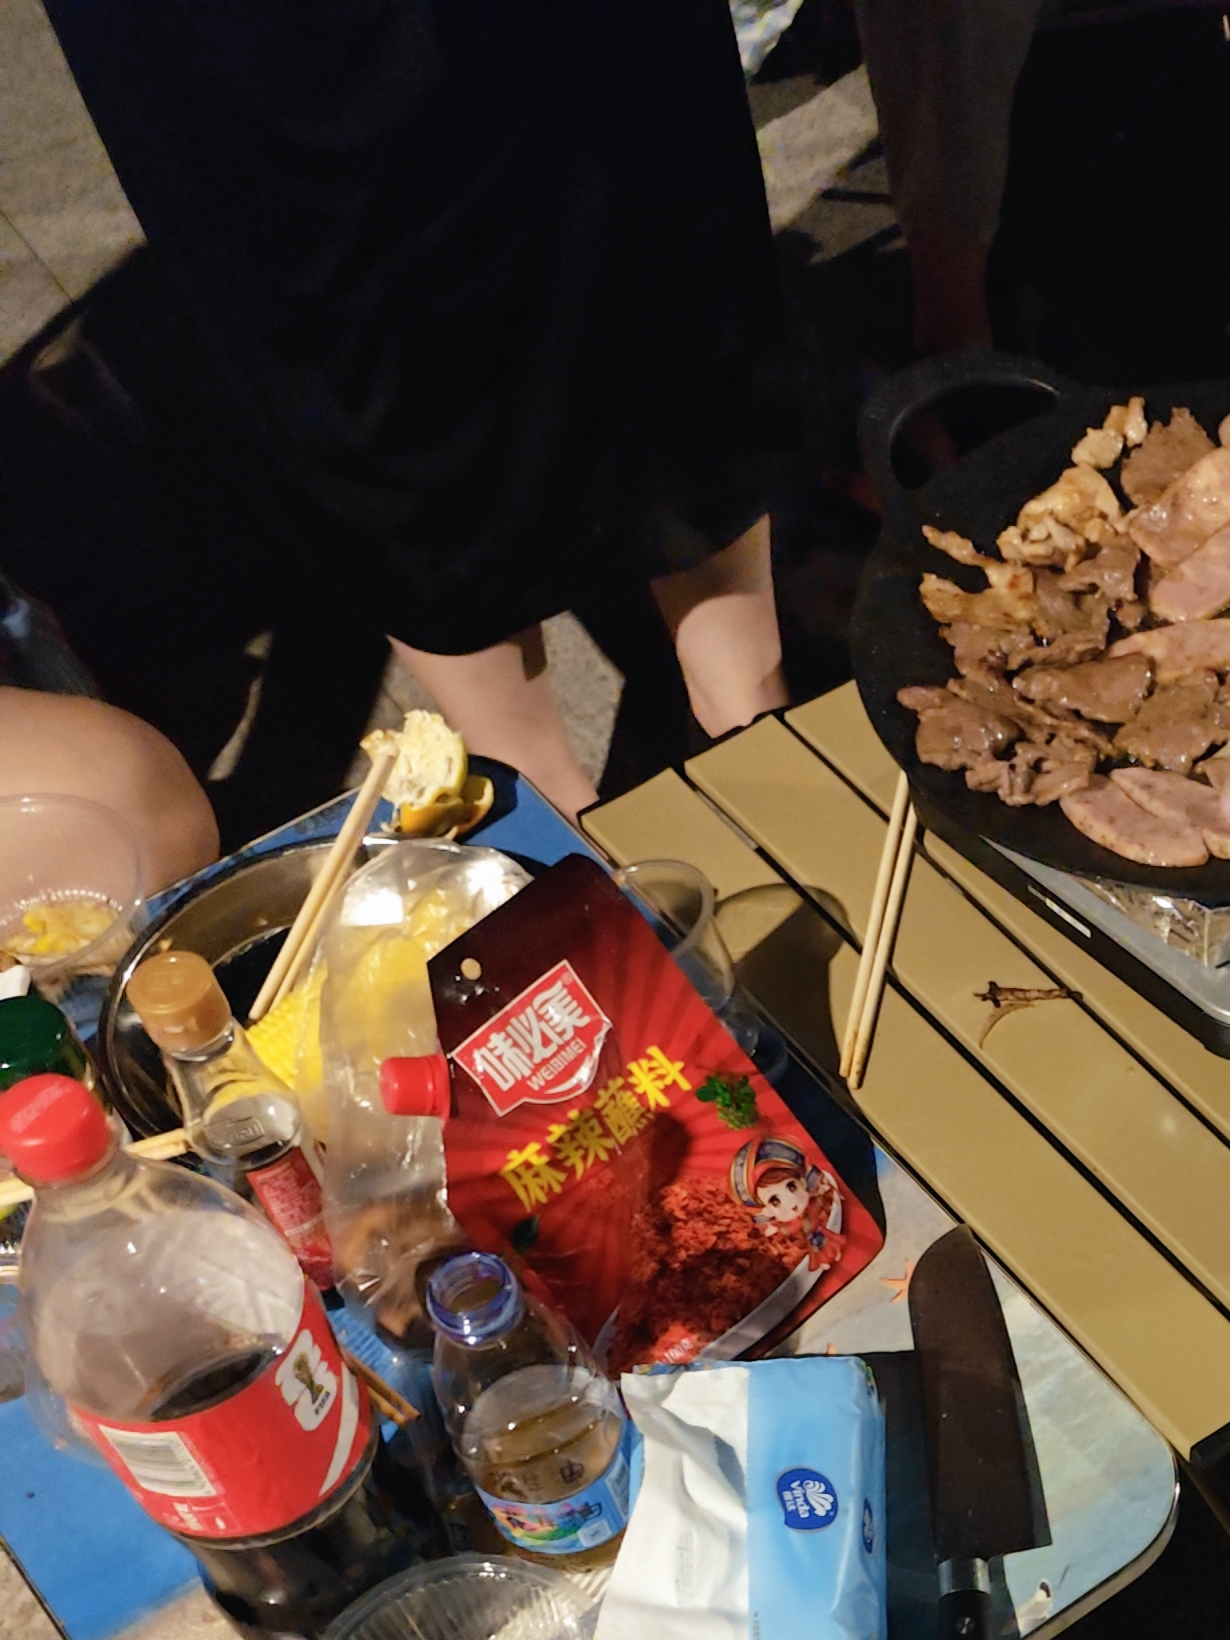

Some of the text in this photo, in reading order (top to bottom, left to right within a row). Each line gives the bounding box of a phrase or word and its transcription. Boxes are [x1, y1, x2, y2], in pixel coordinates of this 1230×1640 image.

[473, 980, 591, 1092] 味必美
[526, 1037, 588, 1091] WEIBIMEI
[502, 1045, 692, 1213] 麻辣蘸料
